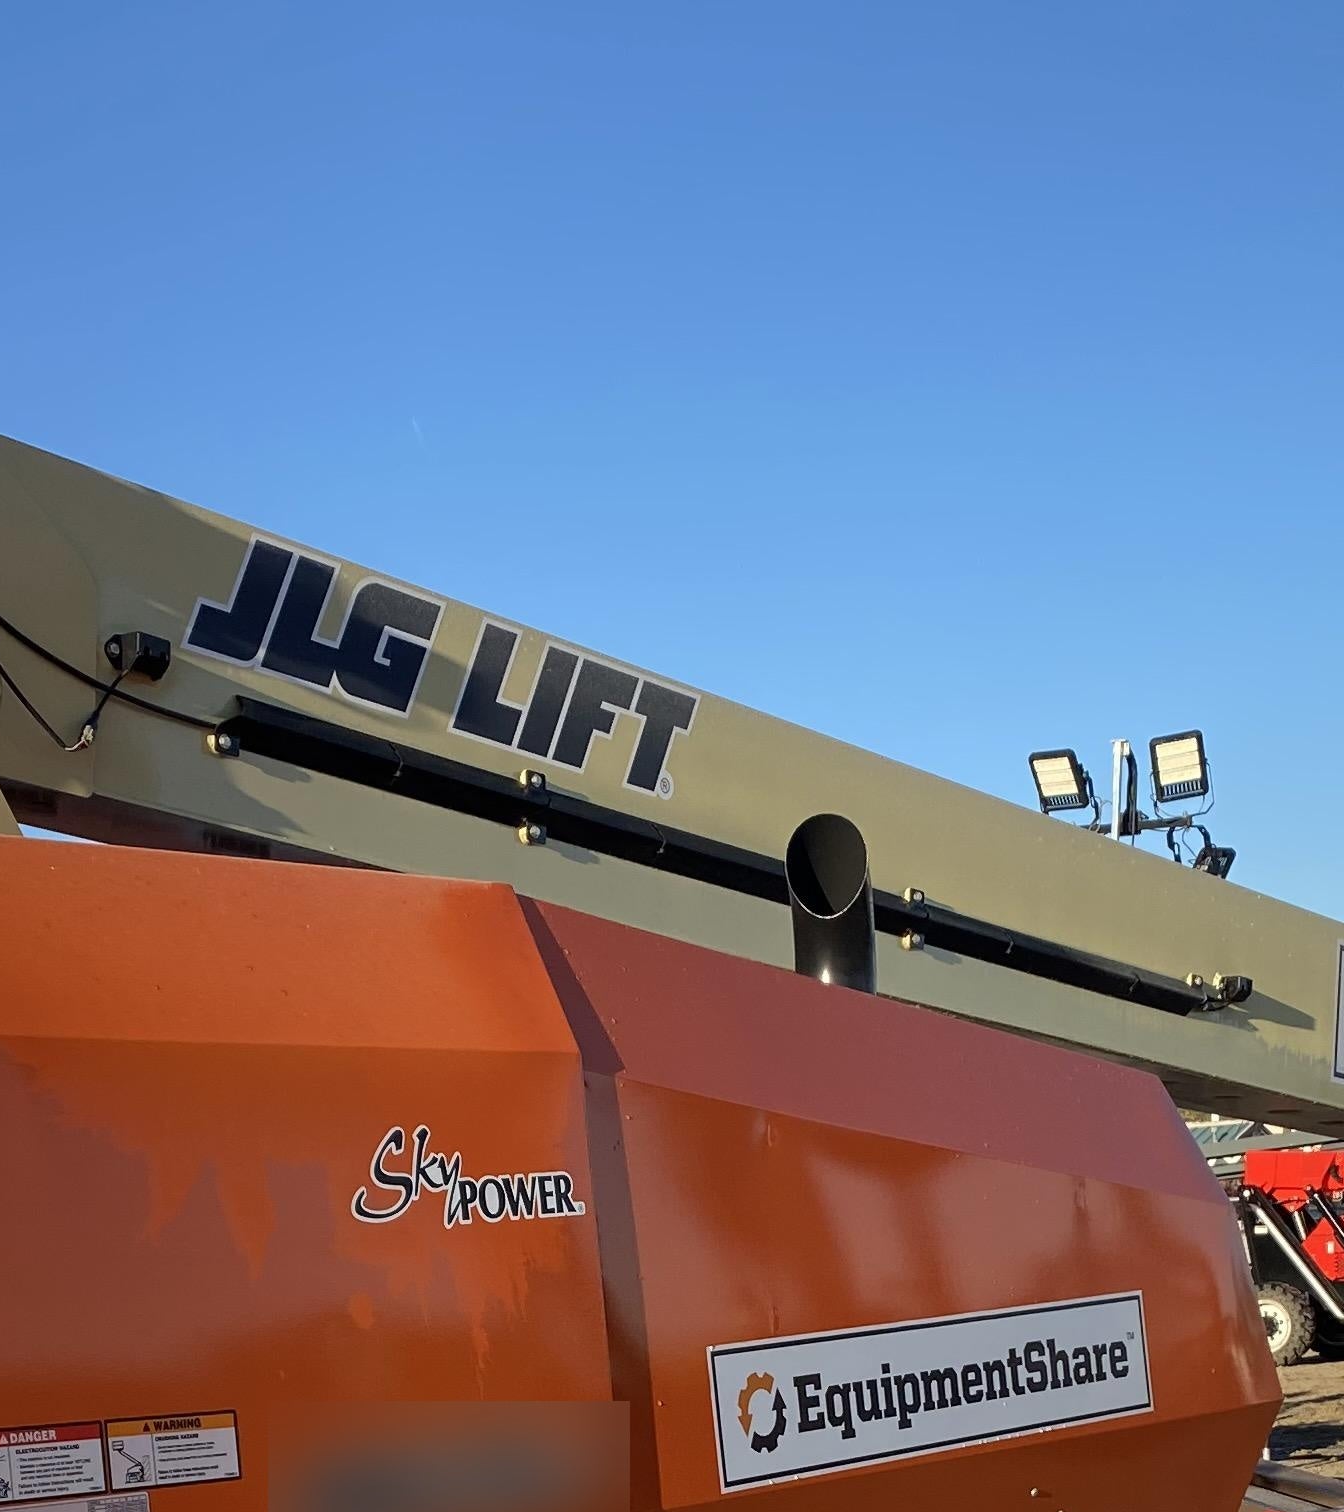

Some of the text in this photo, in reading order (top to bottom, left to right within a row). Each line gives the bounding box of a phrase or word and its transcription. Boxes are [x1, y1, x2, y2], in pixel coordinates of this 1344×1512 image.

[183, 535, 699, 797] JLG LIFT
[354, 1127, 576, 1226] Sky POWER
[10, 1429, 57, 1444] DANGER
[153, 1418, 202, 1432] WARNING
[793, 1339, 1130, 1440] EquipmentShare
